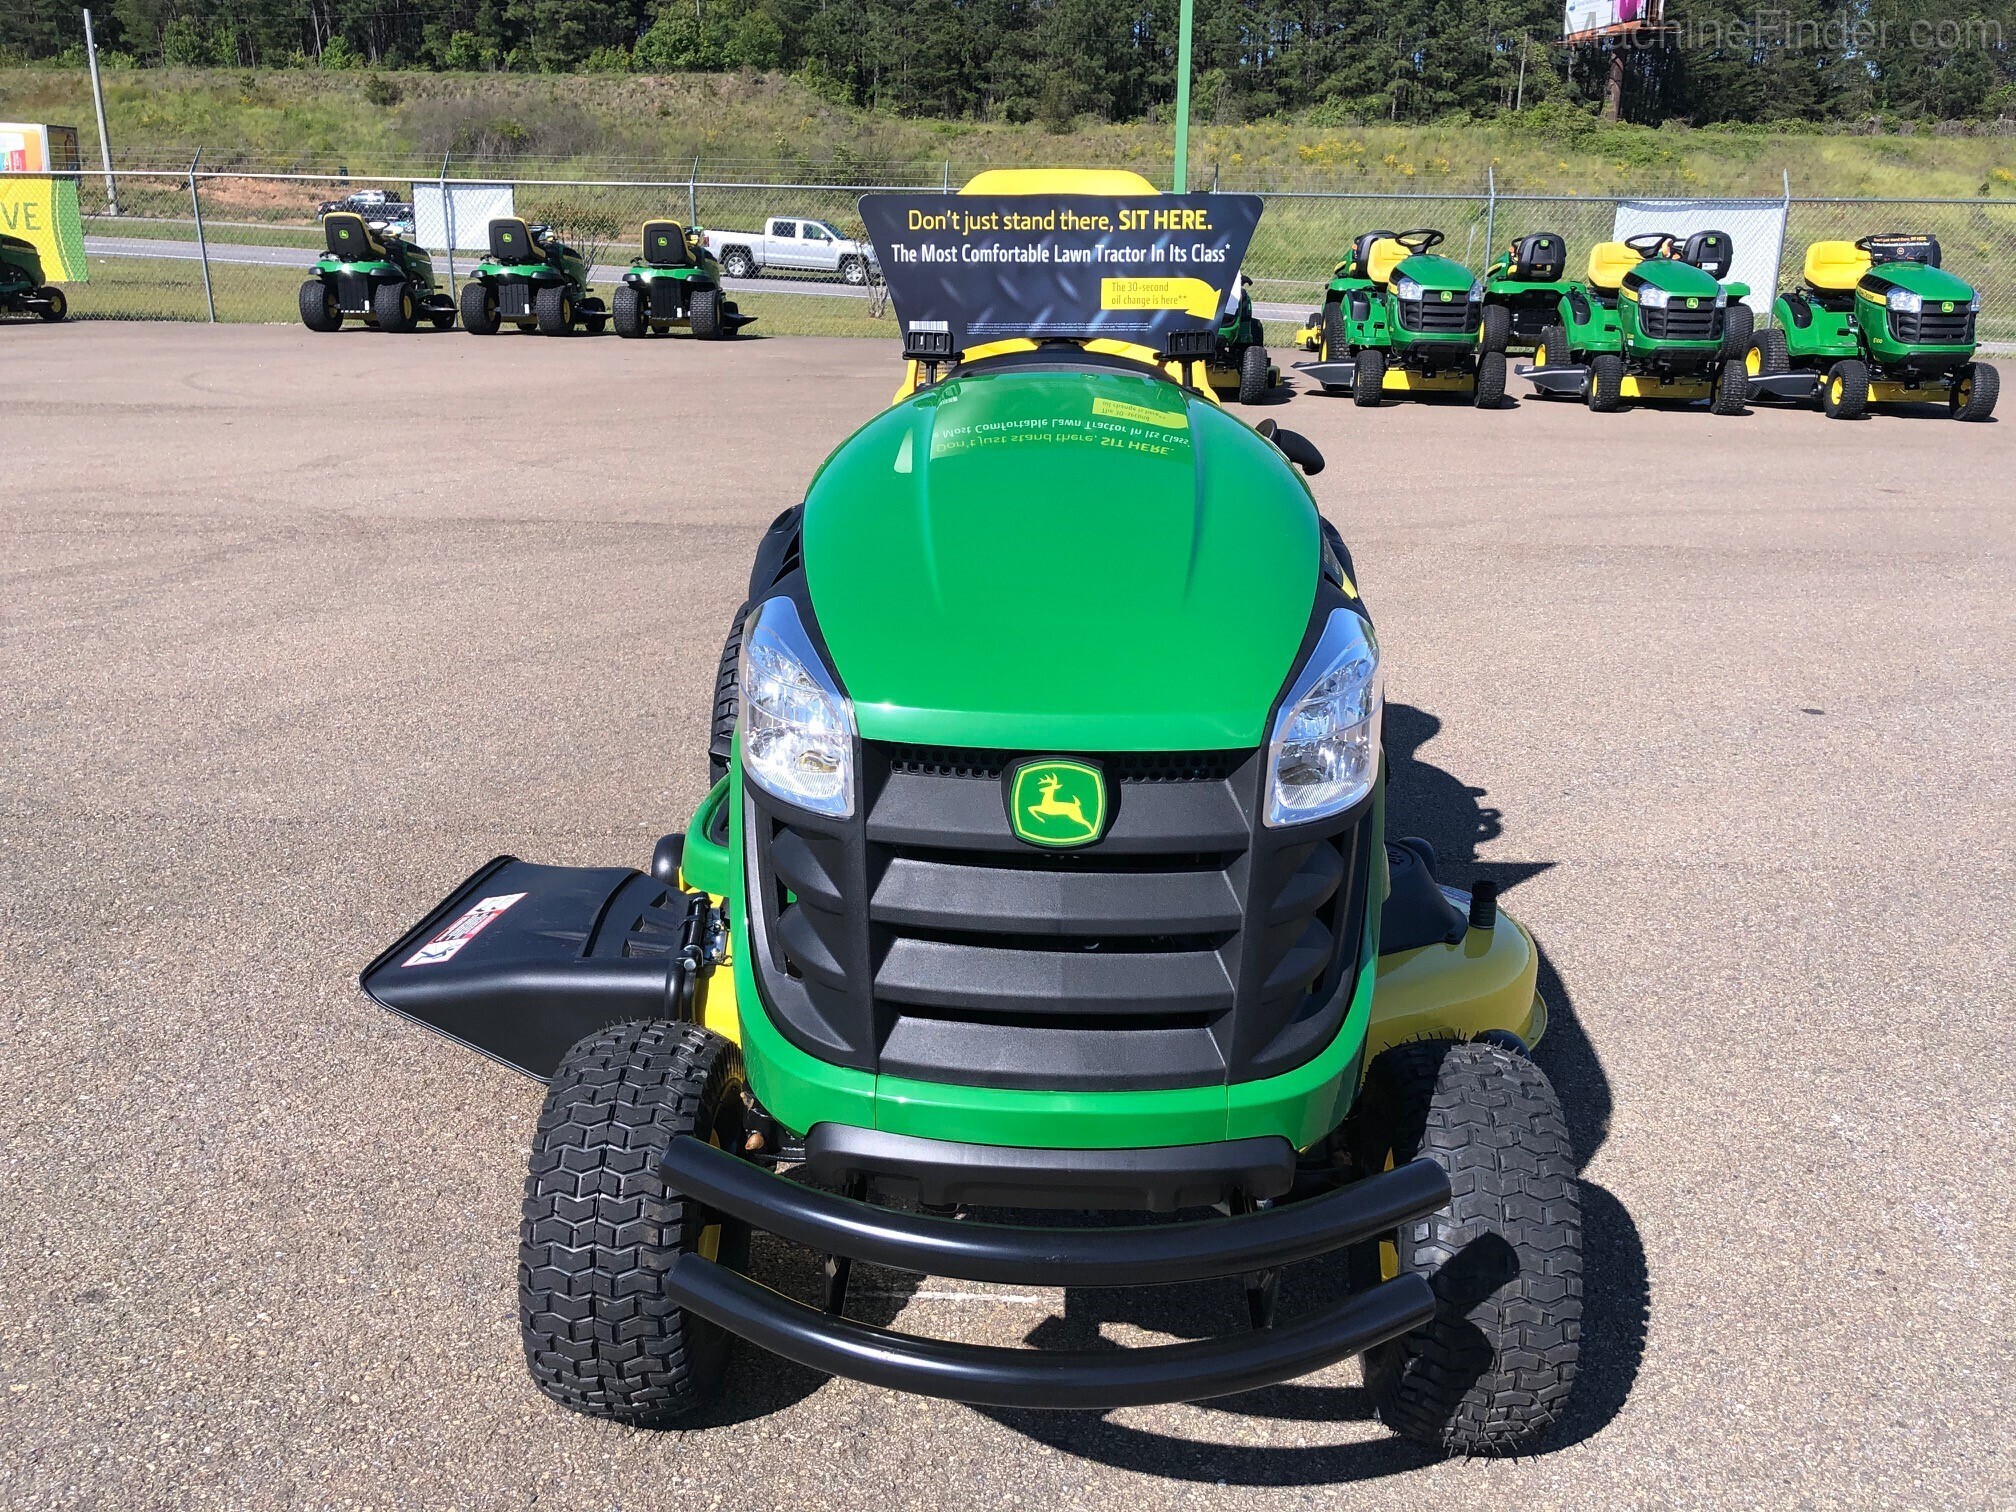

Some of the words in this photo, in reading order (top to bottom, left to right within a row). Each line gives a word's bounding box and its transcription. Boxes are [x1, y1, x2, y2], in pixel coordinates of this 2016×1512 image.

[908, 209, 960, 230] Don't
[962, 210, 999, 236] just
[1003, 209, 1055, 230] stand
[1059, 209, 1114, 232] there,
[1118, 209, 1150, 230] SIT
[1153, 209, 1213, 230] HERE.
[891, 243, 917, 263] The
[921, 243, 958, 263] Most
[961, 243, 1050, 263] Comfortable
[1054, 244, 1091, 263] Lawn
[1095, 244, 1147, 263] Tractor
[1151, 243, 1165, 262] In
[1169, 243, 1187, 262] Its
[1111, 282, 1126, 292] The
[1128, 282, 1169, 292] 30-second
[1111, 295, 1121, 305] oil
[1123, 295, 1151, 307] change
[1152, 295, 1159, 305] is
